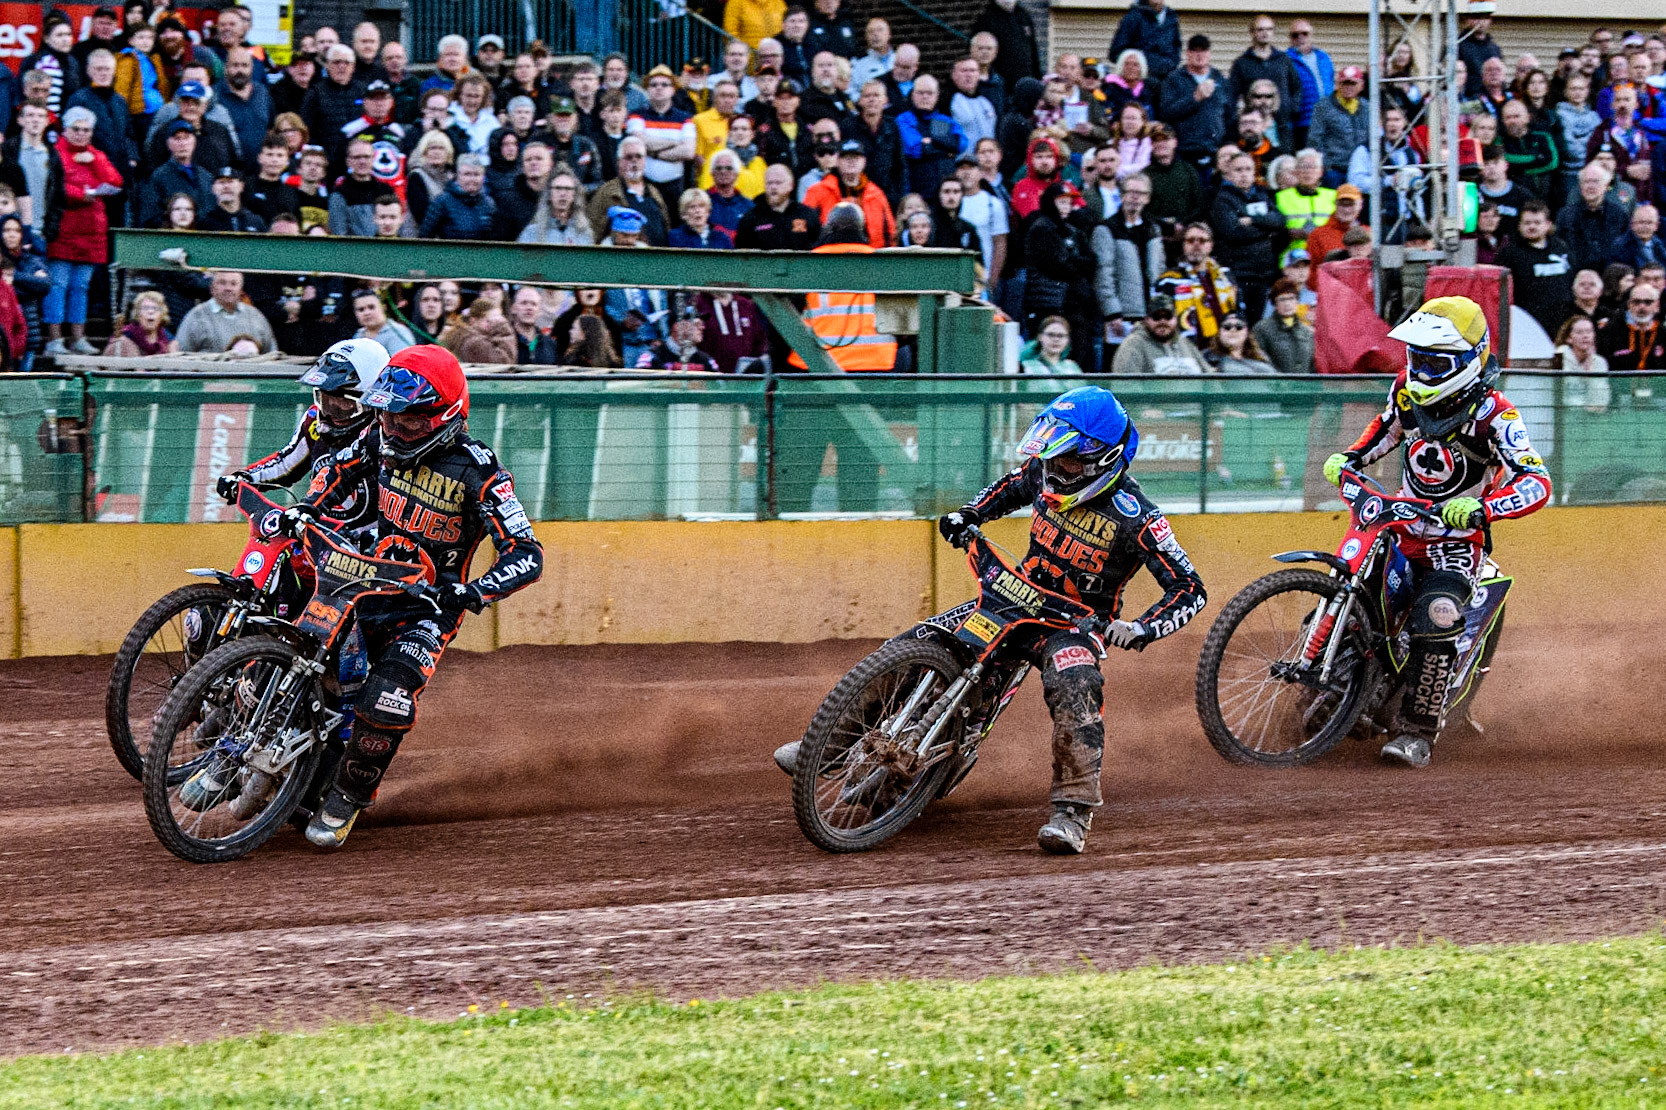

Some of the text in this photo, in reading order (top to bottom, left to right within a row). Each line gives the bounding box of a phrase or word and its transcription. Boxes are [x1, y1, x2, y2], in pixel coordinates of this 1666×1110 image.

[495, 482, 514, 496] NG
[1343, 483, 1361, 497] EDGE
[1150, 519, 1170, 537] NG
[327, 551, 378, 579] PARRYS
[445, 550, 458, 566] 2
[492, 554, 539, 583] LINK
[996, 570, 1047, 610] PARRYS
[1085, 575, 1096, 591] 7
[1150, 594, 1206, 639] Taffys
[1414, 652, 1438, 716] SHOCKS
[1428, 654, 1449, 717] HAGON
[377, 696, 411, 711] ROCK OIL
